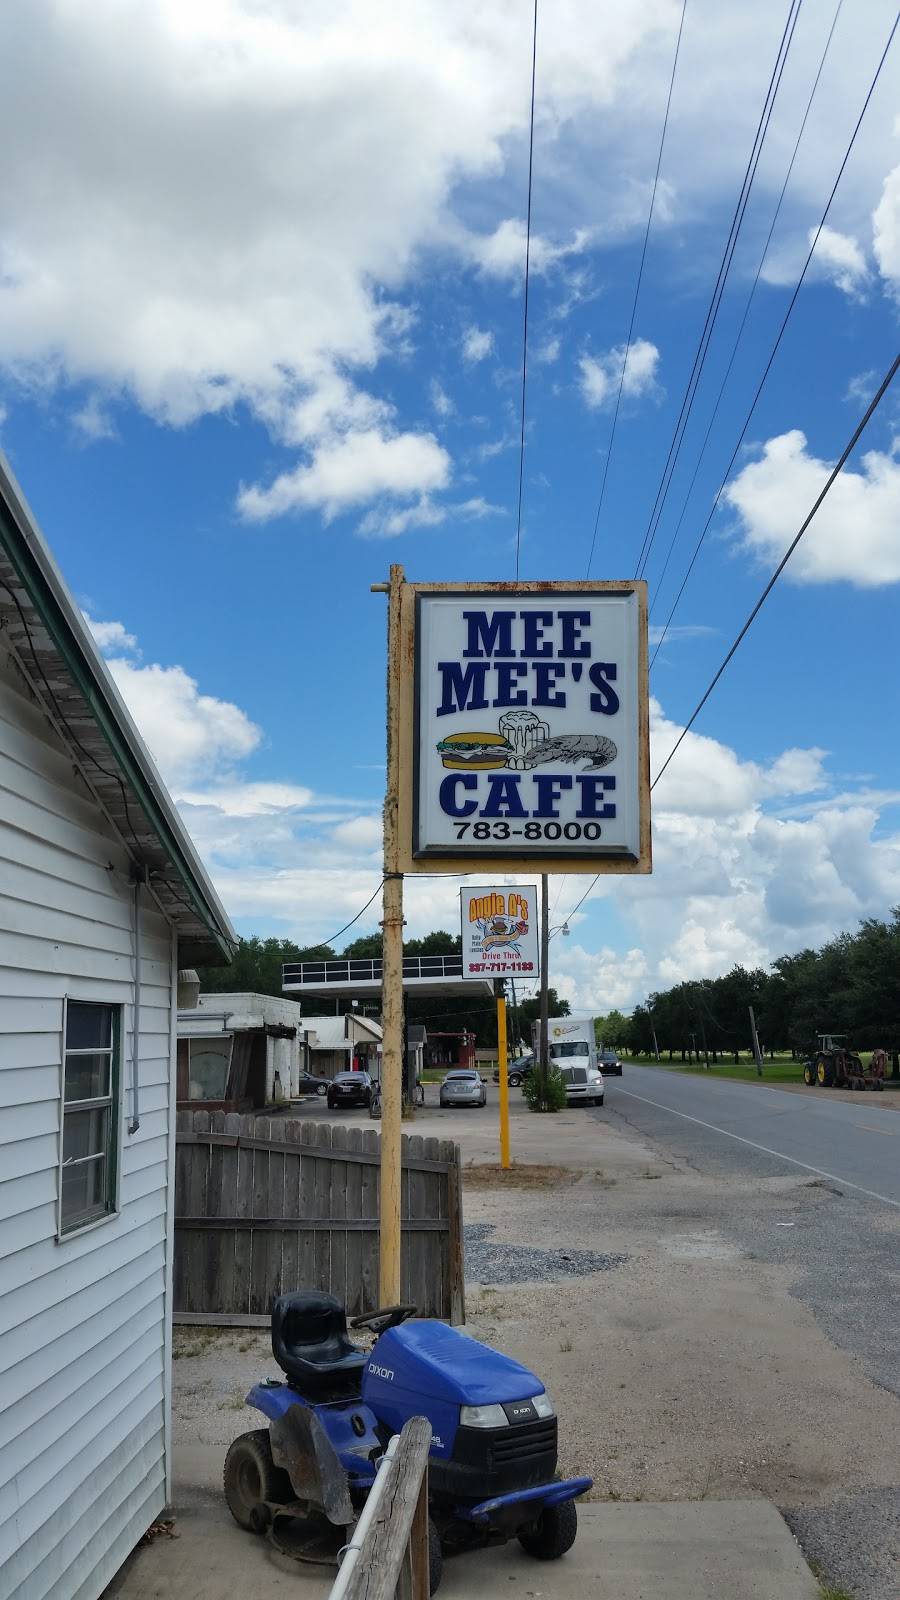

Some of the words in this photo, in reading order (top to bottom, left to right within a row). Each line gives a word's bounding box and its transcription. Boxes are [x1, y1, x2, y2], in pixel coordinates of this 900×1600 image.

[462, 611, 592, 658] MEE
[436, 662, 620, 718] MEE'S
[439, 773, 617, 819] CAFE
[453, 822, 602, 841] 783-8000
[482, 952, 501, 960] Drive
